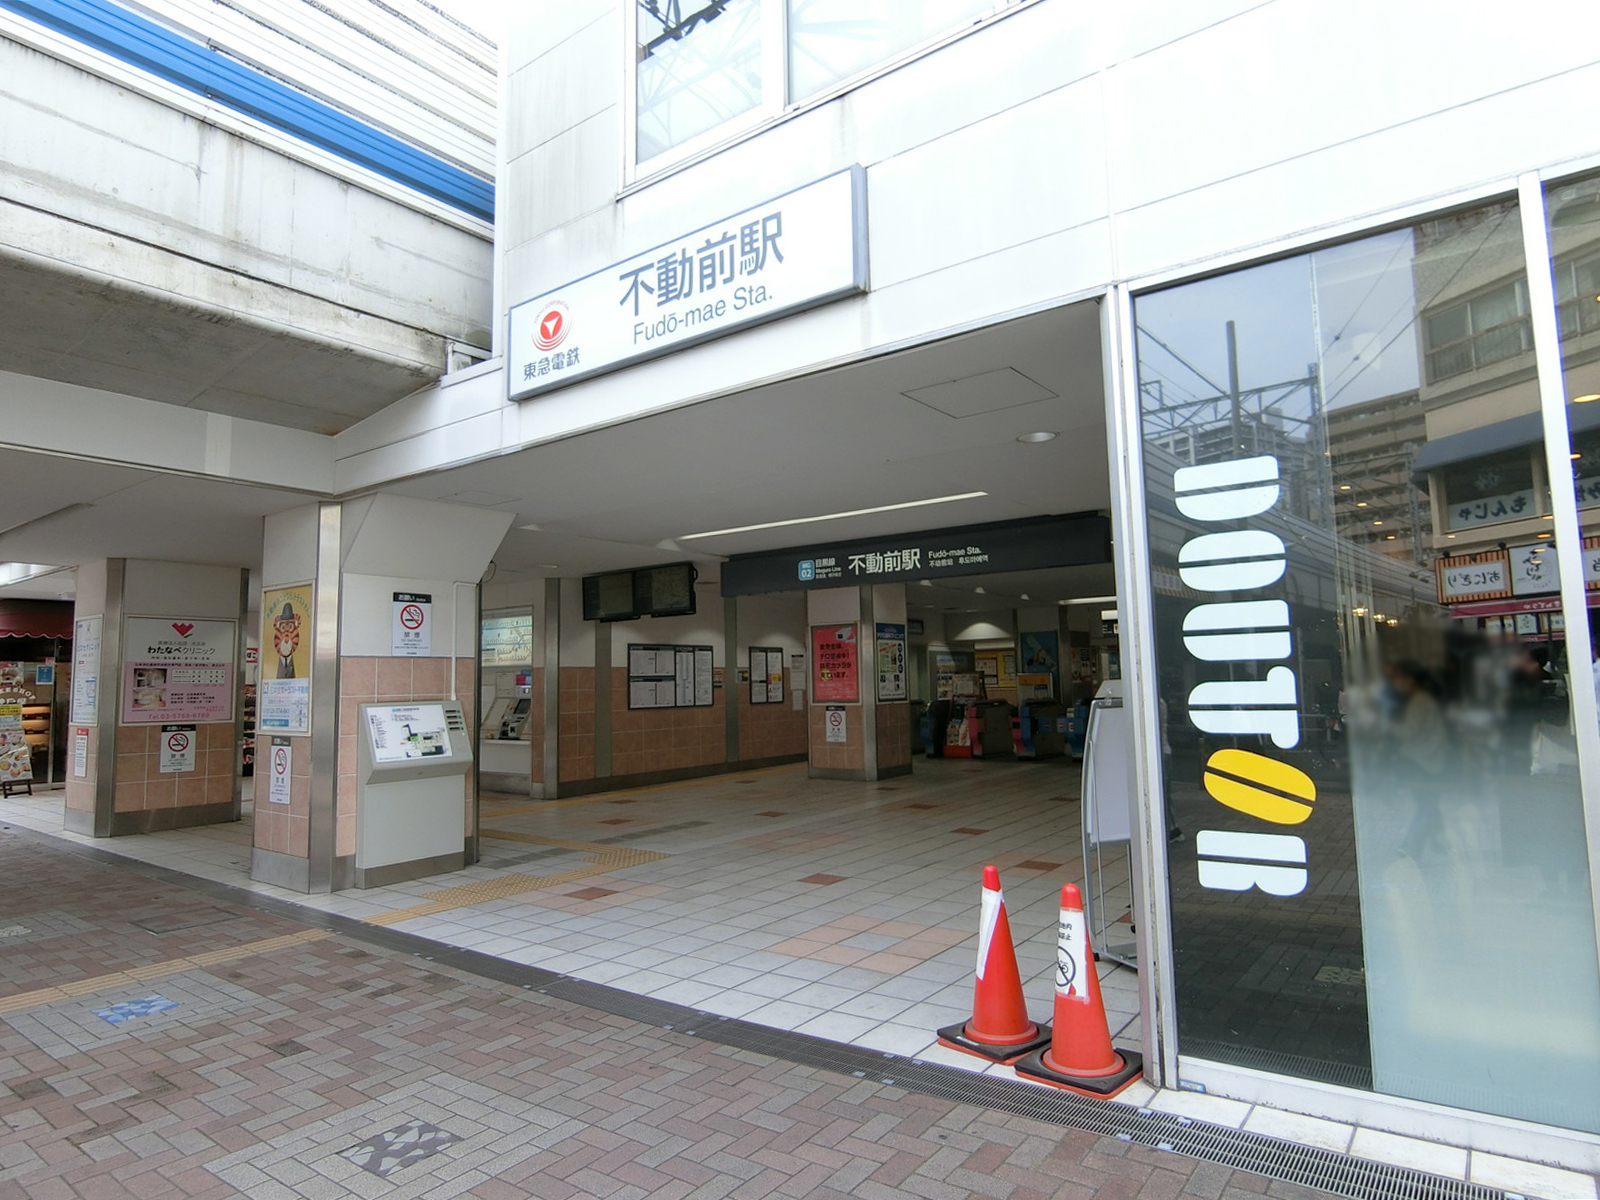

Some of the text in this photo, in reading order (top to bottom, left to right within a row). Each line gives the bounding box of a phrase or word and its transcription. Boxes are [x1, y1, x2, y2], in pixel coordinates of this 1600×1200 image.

[619, 211, 784, 317] 不動前駅
[633, 284, 773, 344] Fudō-mae Sta.
[523, 347, 580, 381] 東急電鉄
[815, 557, 836, 568] 目黒線
[848, 548, 921, 575] 不動前駅
[966, 546, 982, 554] Sta.
[801, 569, 812, 578] 02
[147, 646, 216, 656] わたなべクリニック
[1173, 455, 1317, 896] DOUTOR
